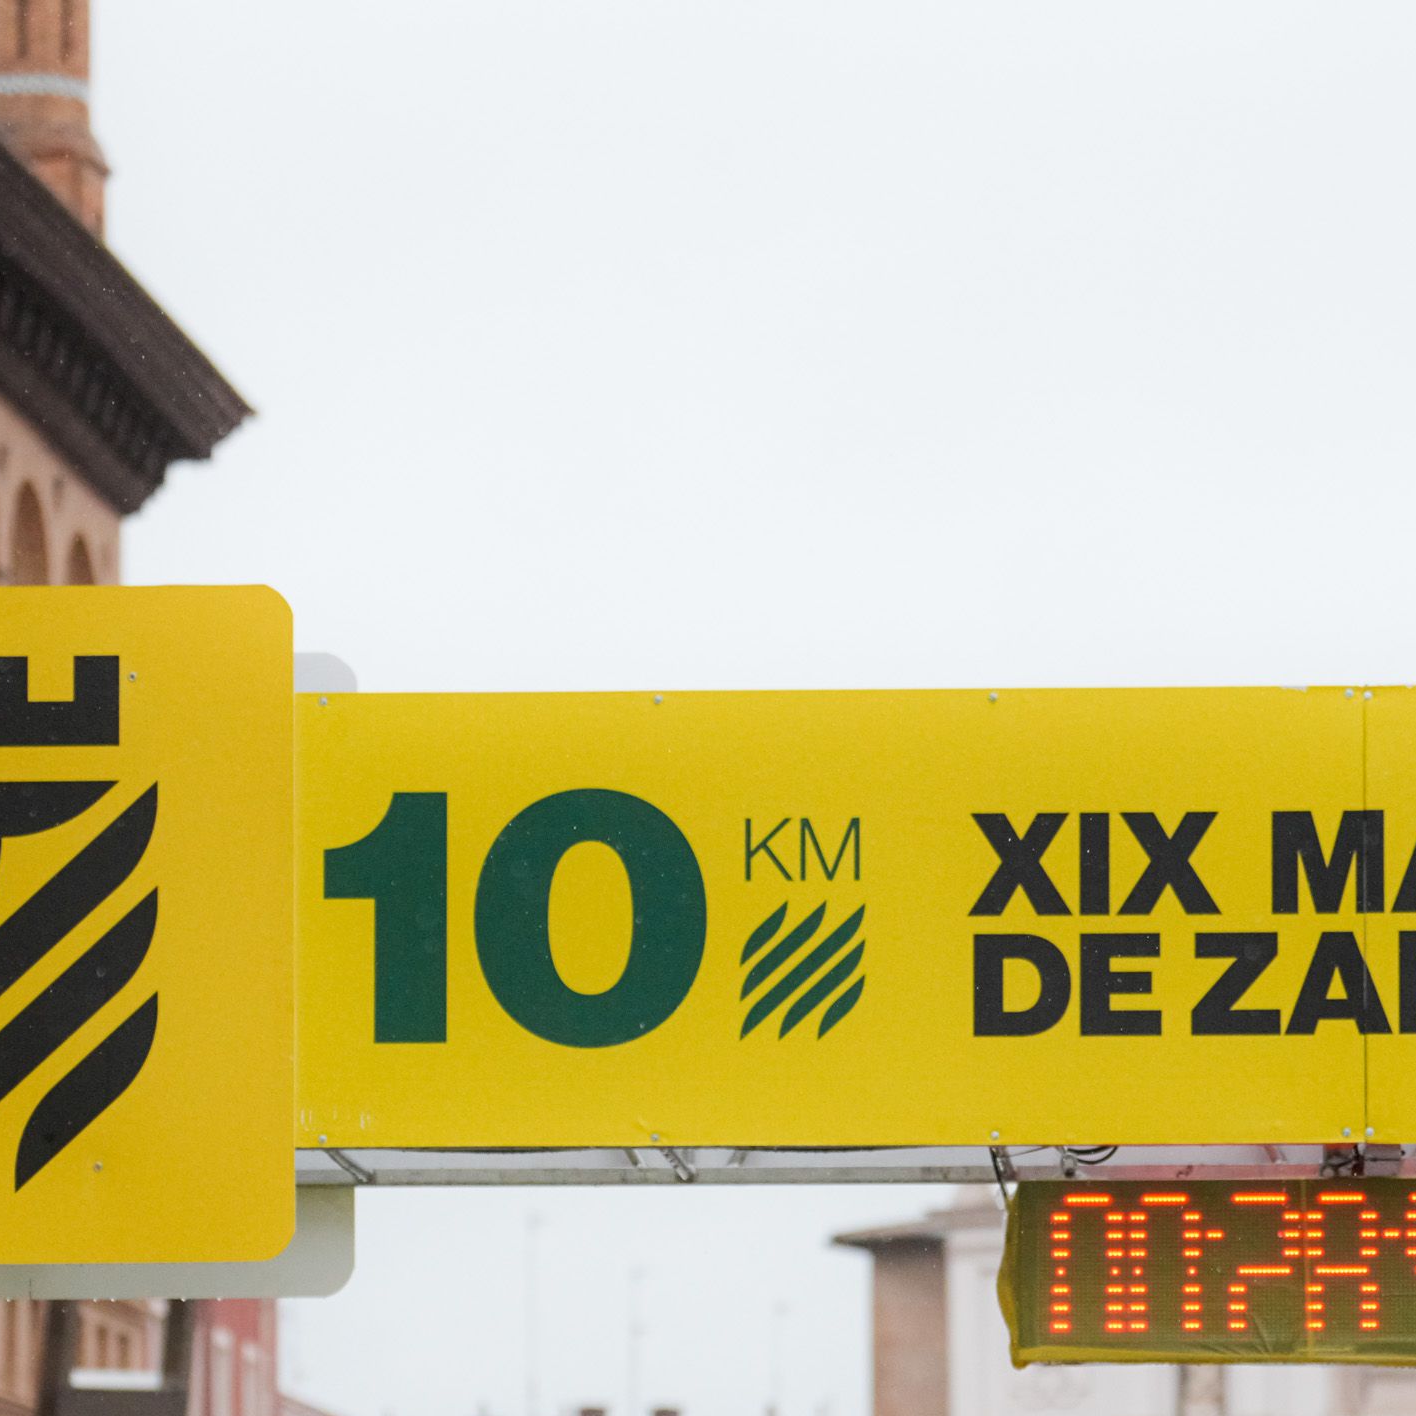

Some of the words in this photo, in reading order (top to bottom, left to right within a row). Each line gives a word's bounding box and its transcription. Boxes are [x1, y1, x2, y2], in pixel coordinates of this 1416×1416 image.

[967, 811, 1220, 917] XIX
[323, 787, 707, 1048] 10
[744, 817, 860, 881] KM
[972, 932, 1162, 1037] DE
